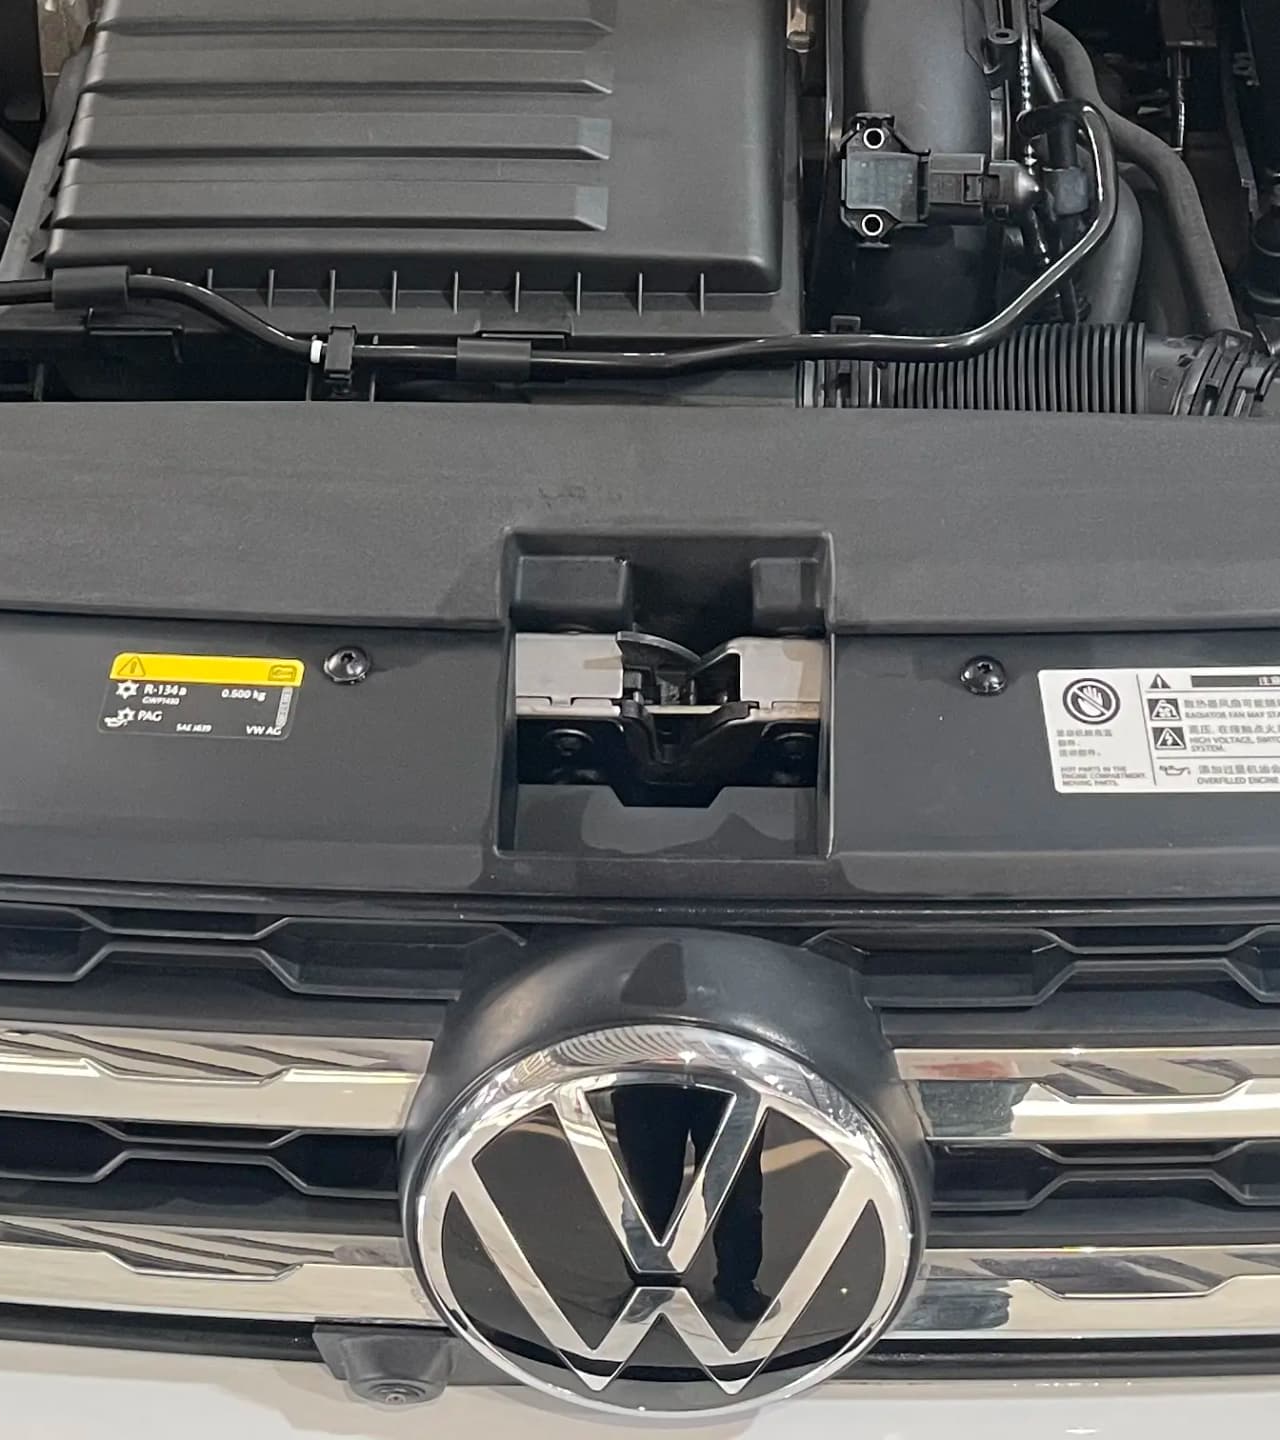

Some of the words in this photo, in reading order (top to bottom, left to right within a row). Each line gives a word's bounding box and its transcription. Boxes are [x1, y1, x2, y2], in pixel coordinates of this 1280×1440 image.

[252, 689, 267, 702] kg
[137, 710, 163, 722] PAG
[246, 725, 266, 735] VW
[265, 726, 282, 736] AG
[428, 1055, 902, 1405] VW
